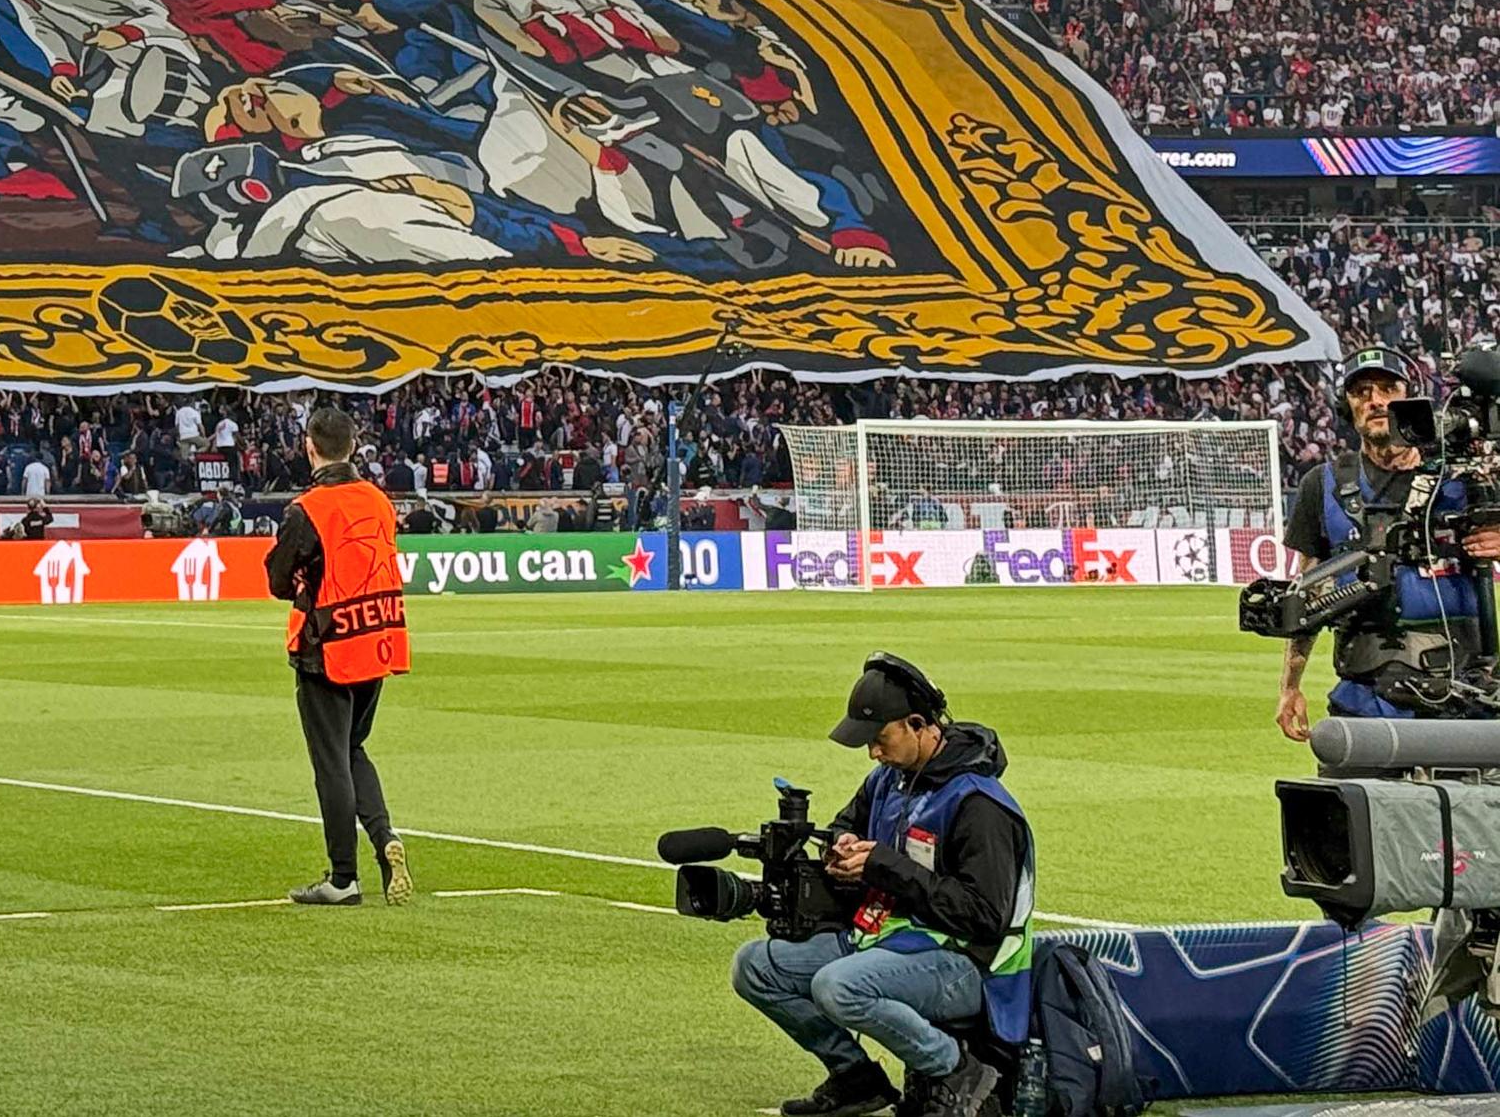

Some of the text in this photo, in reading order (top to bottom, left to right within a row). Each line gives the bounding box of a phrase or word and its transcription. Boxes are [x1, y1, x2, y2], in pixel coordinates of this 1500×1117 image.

[1157, 151, 1237, 168] res.com
[427, 550, 509, 594] you
[517, 548, 597, 582] can
[766, 530, 924, 586] FedEx
[983, 528, 1138, 584] FedEx
